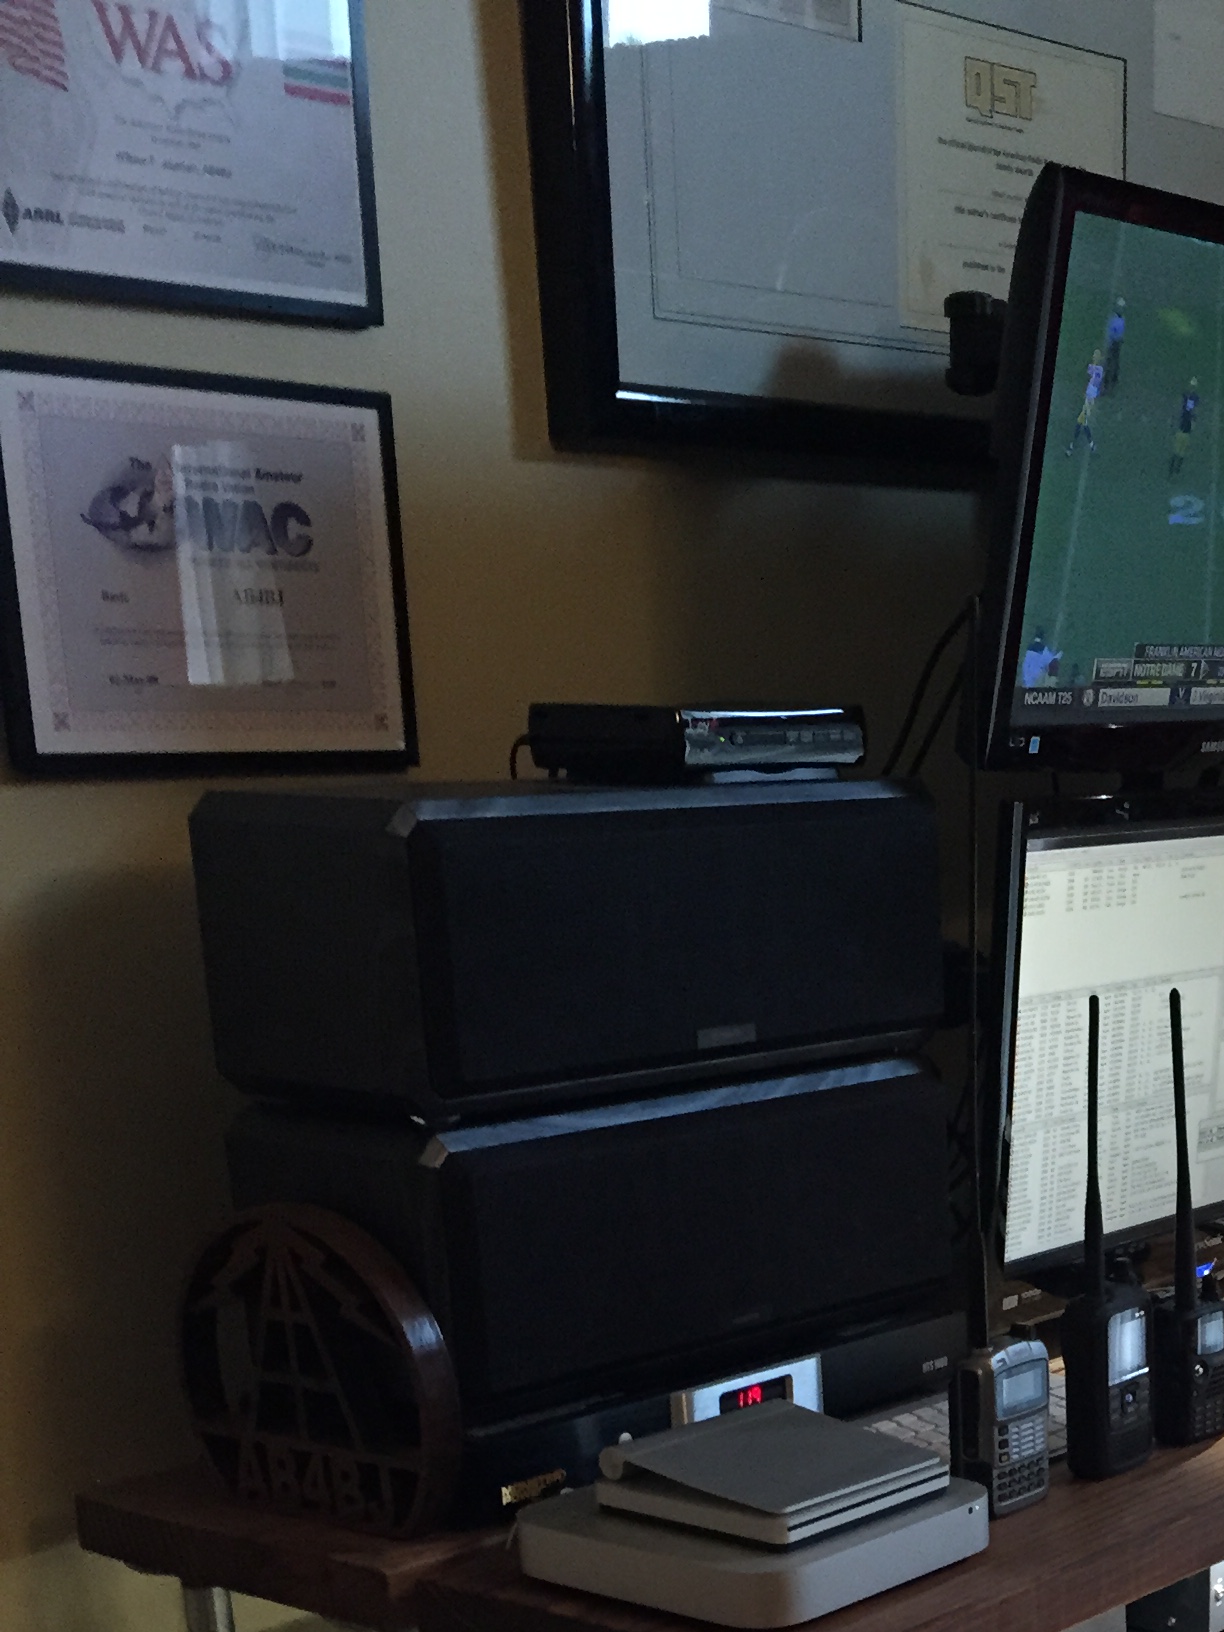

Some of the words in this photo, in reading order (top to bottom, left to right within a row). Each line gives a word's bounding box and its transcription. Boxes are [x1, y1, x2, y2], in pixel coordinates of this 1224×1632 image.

[91, 0, 234, 86] WAS
[965, 56, 1037, 118] QST
[1179, 646, 1212, 658] AMERICAN
[1133, 663, 1161, 678] NOTRE
[1190, 662, 1198, 677] 7
[1024, 692, 1057, 706] NCAAM
[1101, 691, 1139, 705] Davidson
